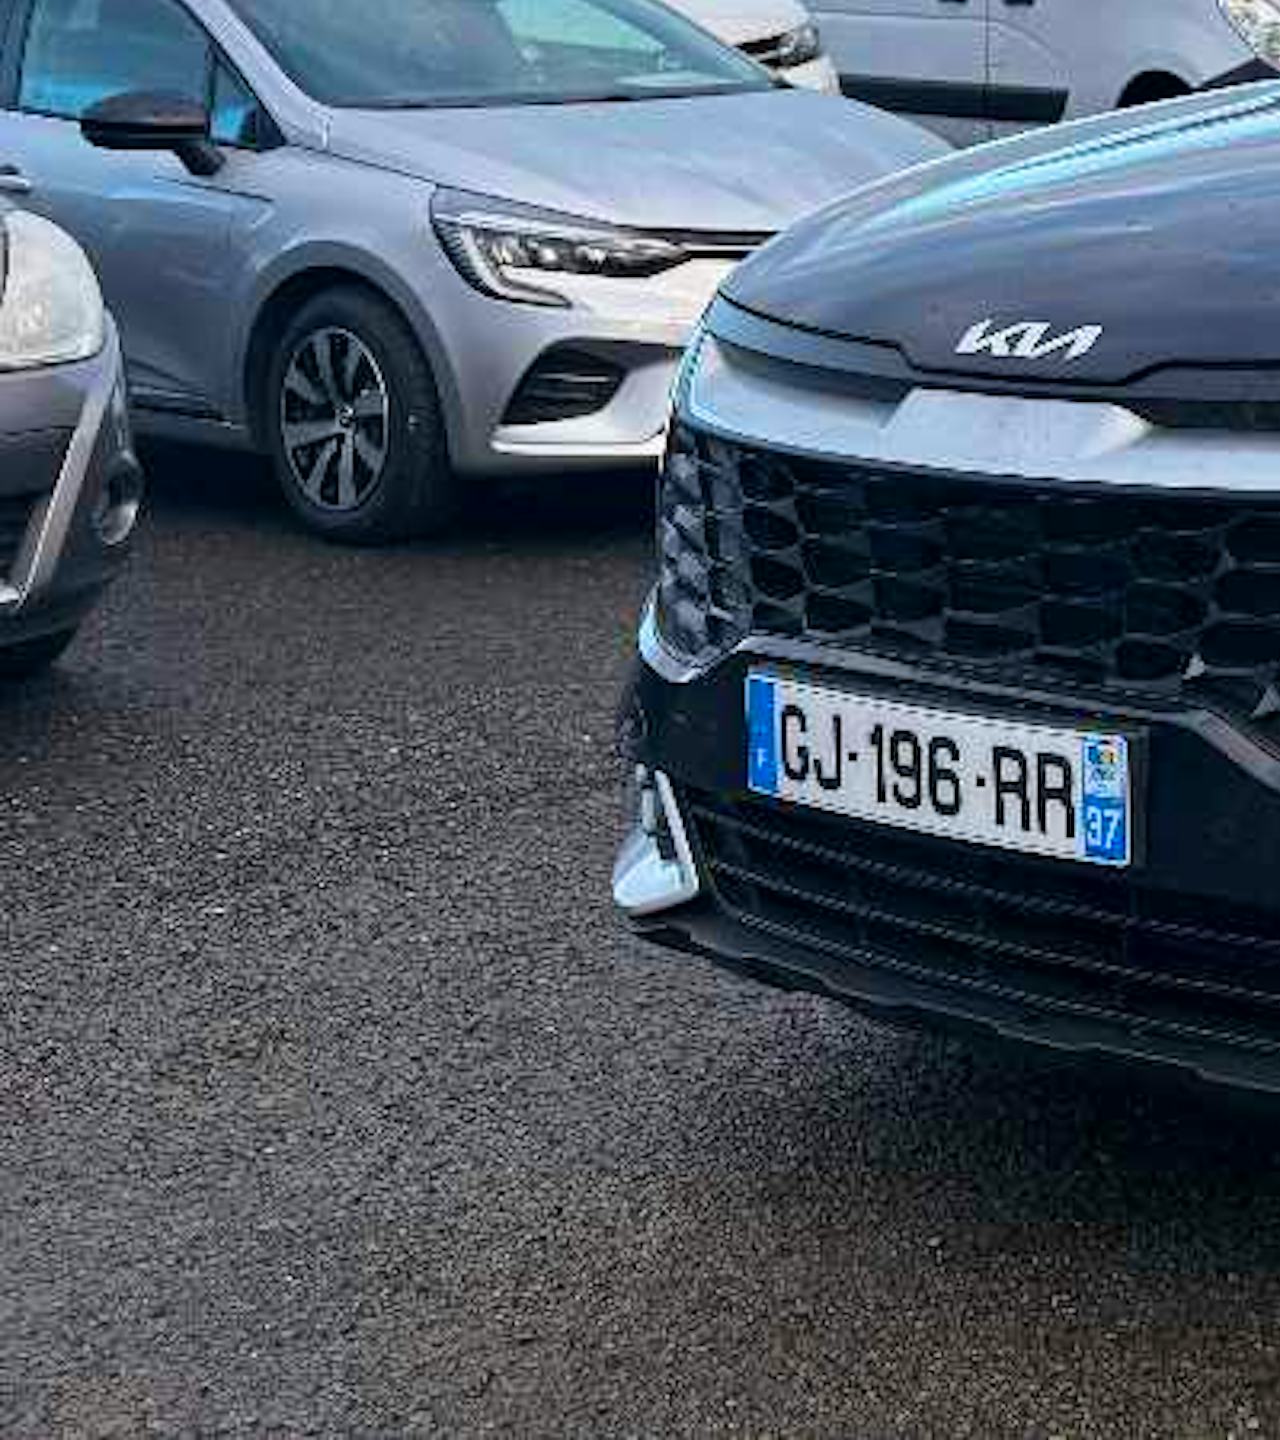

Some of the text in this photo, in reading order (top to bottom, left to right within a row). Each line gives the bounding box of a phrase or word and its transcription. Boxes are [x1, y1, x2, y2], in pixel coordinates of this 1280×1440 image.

[954, 318, 1103, 360] KIA
[781, 704, 1075, 838] GJ-196-RR
[1086, 805, 1121, 849] 37
